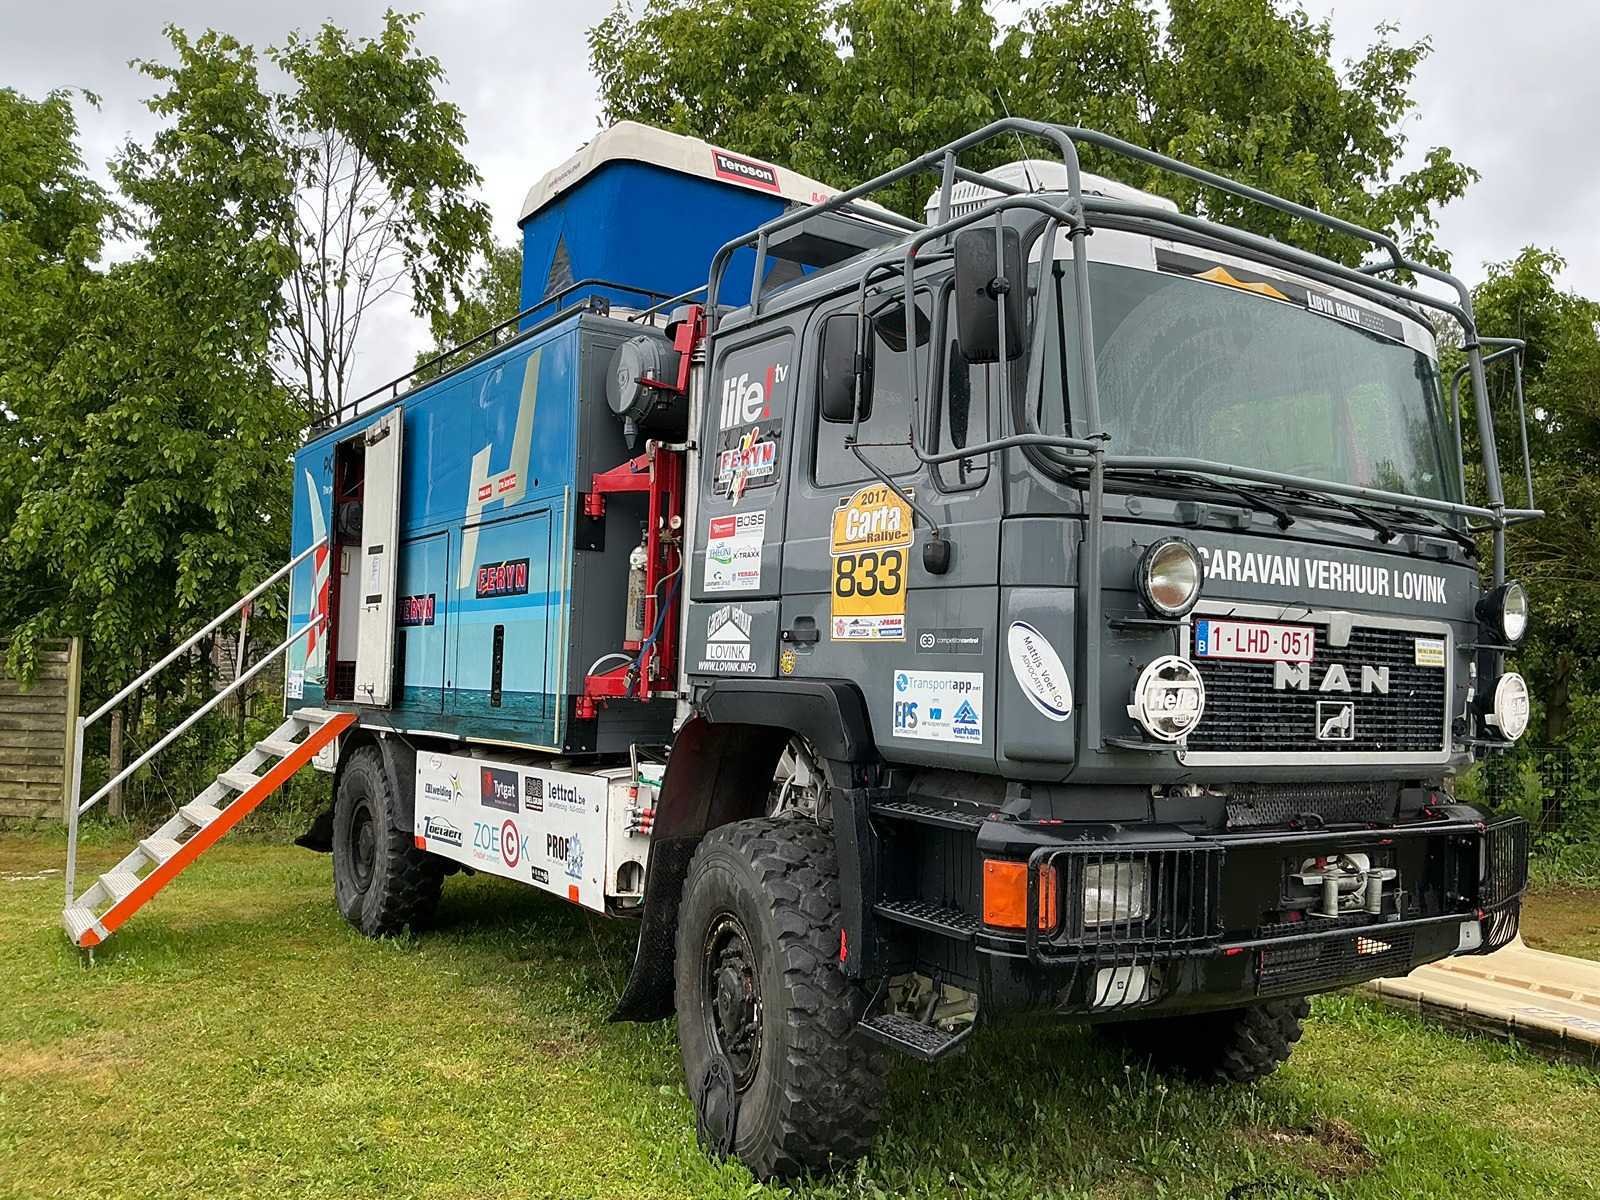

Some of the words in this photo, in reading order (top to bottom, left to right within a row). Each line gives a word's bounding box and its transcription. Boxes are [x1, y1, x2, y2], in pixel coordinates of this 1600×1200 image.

[717, 155, 773, 181] Teroson
[1306, 290, 1335, 315] LIBYA
[1335, 302, 1360, 324] RALLY
[775, 363, 789, 383] tv
[861, 490, 888, 506] 2017
[737, 514, 765, 527] BOSS
[846, 506, 901, 541] Carta
[866, 530, 902, 543] Rallye
[836, 550, 903, 597] 833
[1198, 547, 1300, 588] CARAVAN
[1304, 558, 1390, 596] VERHUUR
[1394, 570, 1447, 604] LOVINK
[710, 645, 745, 659] LOVINK
[1199, 640, 1207, 651] B
[1213, 626, 1310, 656] 1-LHD-051
[698, 661, 757, 673] WWW.LOVINK.INFO
[1022, 654, 1044, 695] ADVOCATEN
[1024, 636, 1043, 669] Mattijs
[1041, 670, 1057, 692] Voet
[1053, 694, 1063, 708] Co
[1273, 660, 1390, 694] MAN
[895, 701, 918, 729] EPS
[952, 726, 981, 736] vanham
[493, 780, 516, 799] Tytgat
[546, 833, 569, 861] PROF
